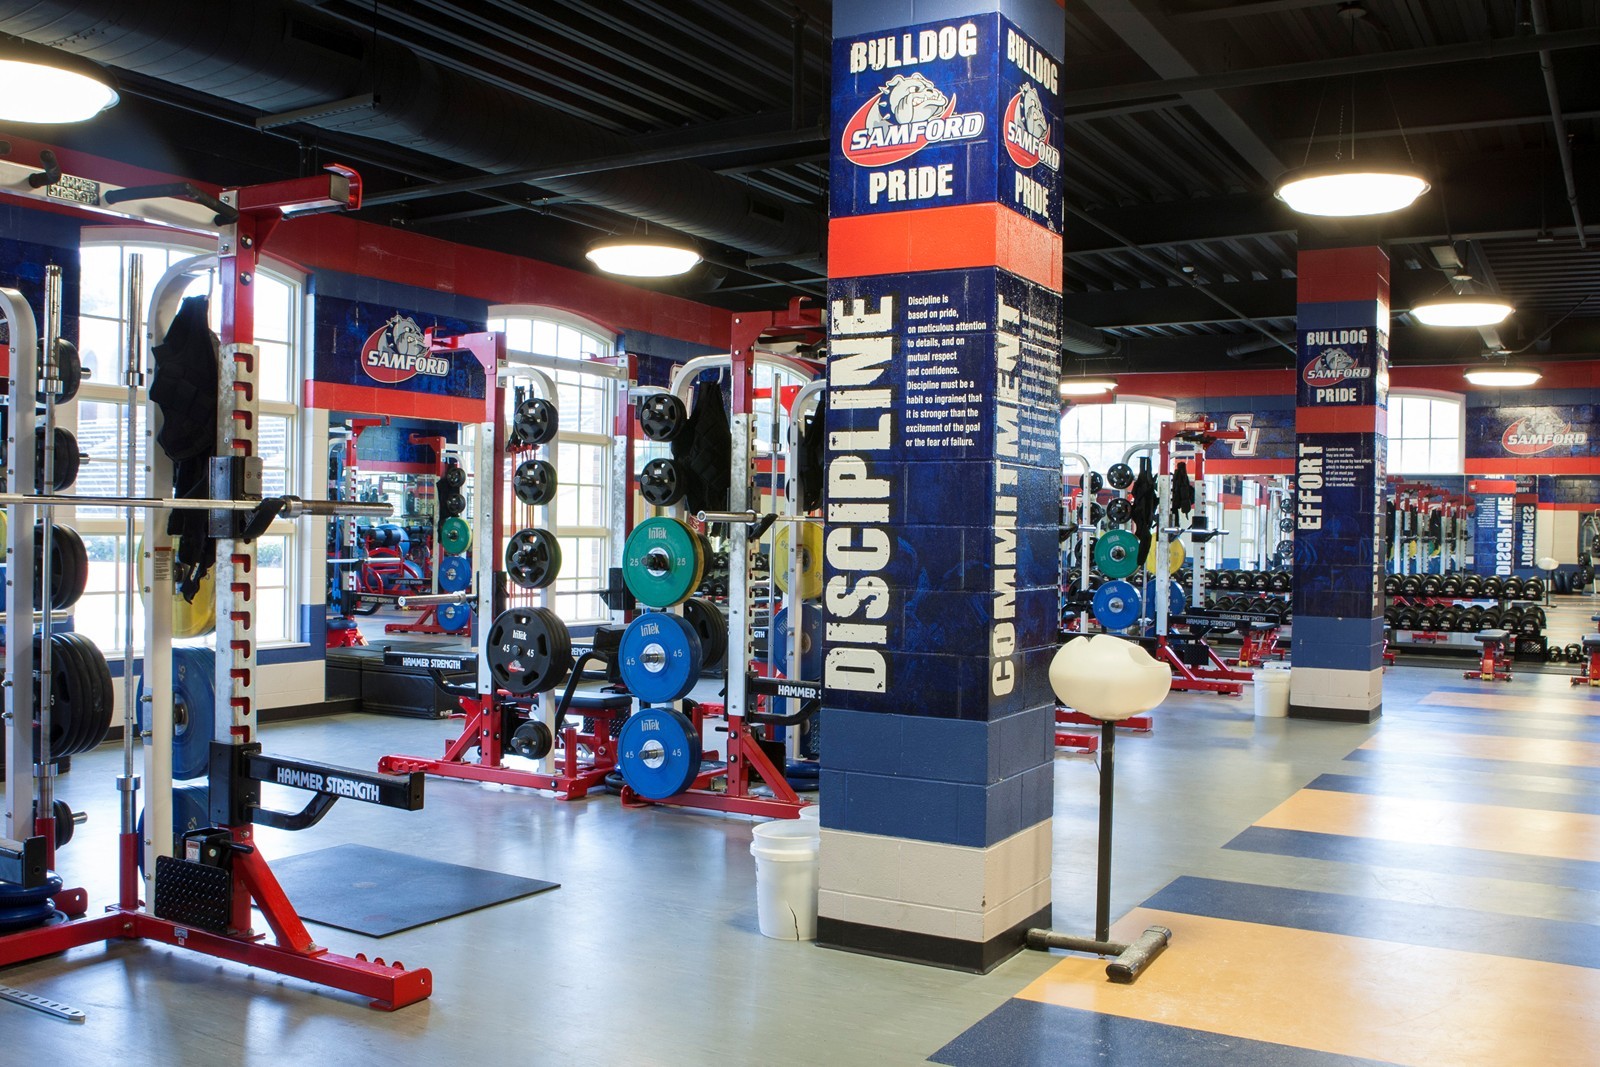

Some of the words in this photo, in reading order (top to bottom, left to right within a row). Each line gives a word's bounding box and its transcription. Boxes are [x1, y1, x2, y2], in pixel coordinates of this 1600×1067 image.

[850, 23, 977, 74] BULLDOG
[1007, 28, 1058, 96] BULLDOG
[850, 112, 985, 151] SAMFORD
[1006, 122, 1060, 172] SAMFORD
[869, 163, 953, 205] PRIDE
[1014, 170, 1050, 218] PRIDE
[908, 295, 941, 306] Discipline
[942, 294, 949, 303] is
[908, 310, 928, 319] based
[939, 308, 959, 319] pride,
[908, 326, 916, 334] on
[917, 323, 954, 333] meticulous
[955, 321, 986, 331] attention
[907, 339, 915, 347] to
[916, 337, 940, 348] details,
[941, 336, 955, 346] and
[956, 337, 965, 345] on
[1306, 329, 1368, 346] BULLDOG
[907, 352, 931, 362] mutual
[931, 351, 957, 362] respect
[367, 351, 448, 375] SAMFORD
[907, 367, 920, 376] and
[921, 366, 960, 375] confidence.
[1307, 366, 1371, 379] SAMFORD
[906, 381, 940, 391] Discipline
[941, 380, 958, 389] must
[959, 379, 969, 388] be
[906, 395, 923, 404] habit
[925, 396, 933, 404] so
[934, 393, 966, 405] ingrained
[968, 393, 982, 402] that
[1316, 387, 1357, 403] PRIDE
[906, 409, 911, 418] it
[912, 409, 919, 418] is
[920, 409, 949, 419] stronger
[950, 408, 966, 418] than
[967, 408, 979, 417] the
[905, 423, 943, 433] excitement
[944, 422, 952, 432] of
[953, 423, 964, 432] the
[965, 422, 981, 433] goal
[905, 439, 913, 447] or
[914, 438, 925, 447] the
[926, 437, 941, 446] fear
[942, 437, 950, 446] of
[950, 437, 975, 447] failure.
[1507, 432, 1587, 446] SAMFORD
[1297, 443, 1323, 530] EFFORT
[824, 295, 894, 693] DISCIPLINE
[991, 294, 1021, 697] COMMITMENT
[648, 527, 667, 539] InTek
[630, 558, 639, 566] 25
[677, 558, 686, 566] 25
[512, 629, 527, 640] InTek
[640, 622, 660, 637] InTek
[502, 644, 510, 653] 45
[526, 649, 535, 658] 45
[673, 649, 683, 658] 45
[402, 657, 430, 668] HAMMER
[430, 659, 461, 670] STRENGTH
[626, 657, 636, 666] 45
[778, 684, 816, 699] HAMMER
[641, 719, 660, 732] InTek
[625, 751, 635, 759] 45
[672, 748, 682, 757] 45
[277, 767, 324, 791] HAMMER
[326, 776, 380, 802] STRENGTH
